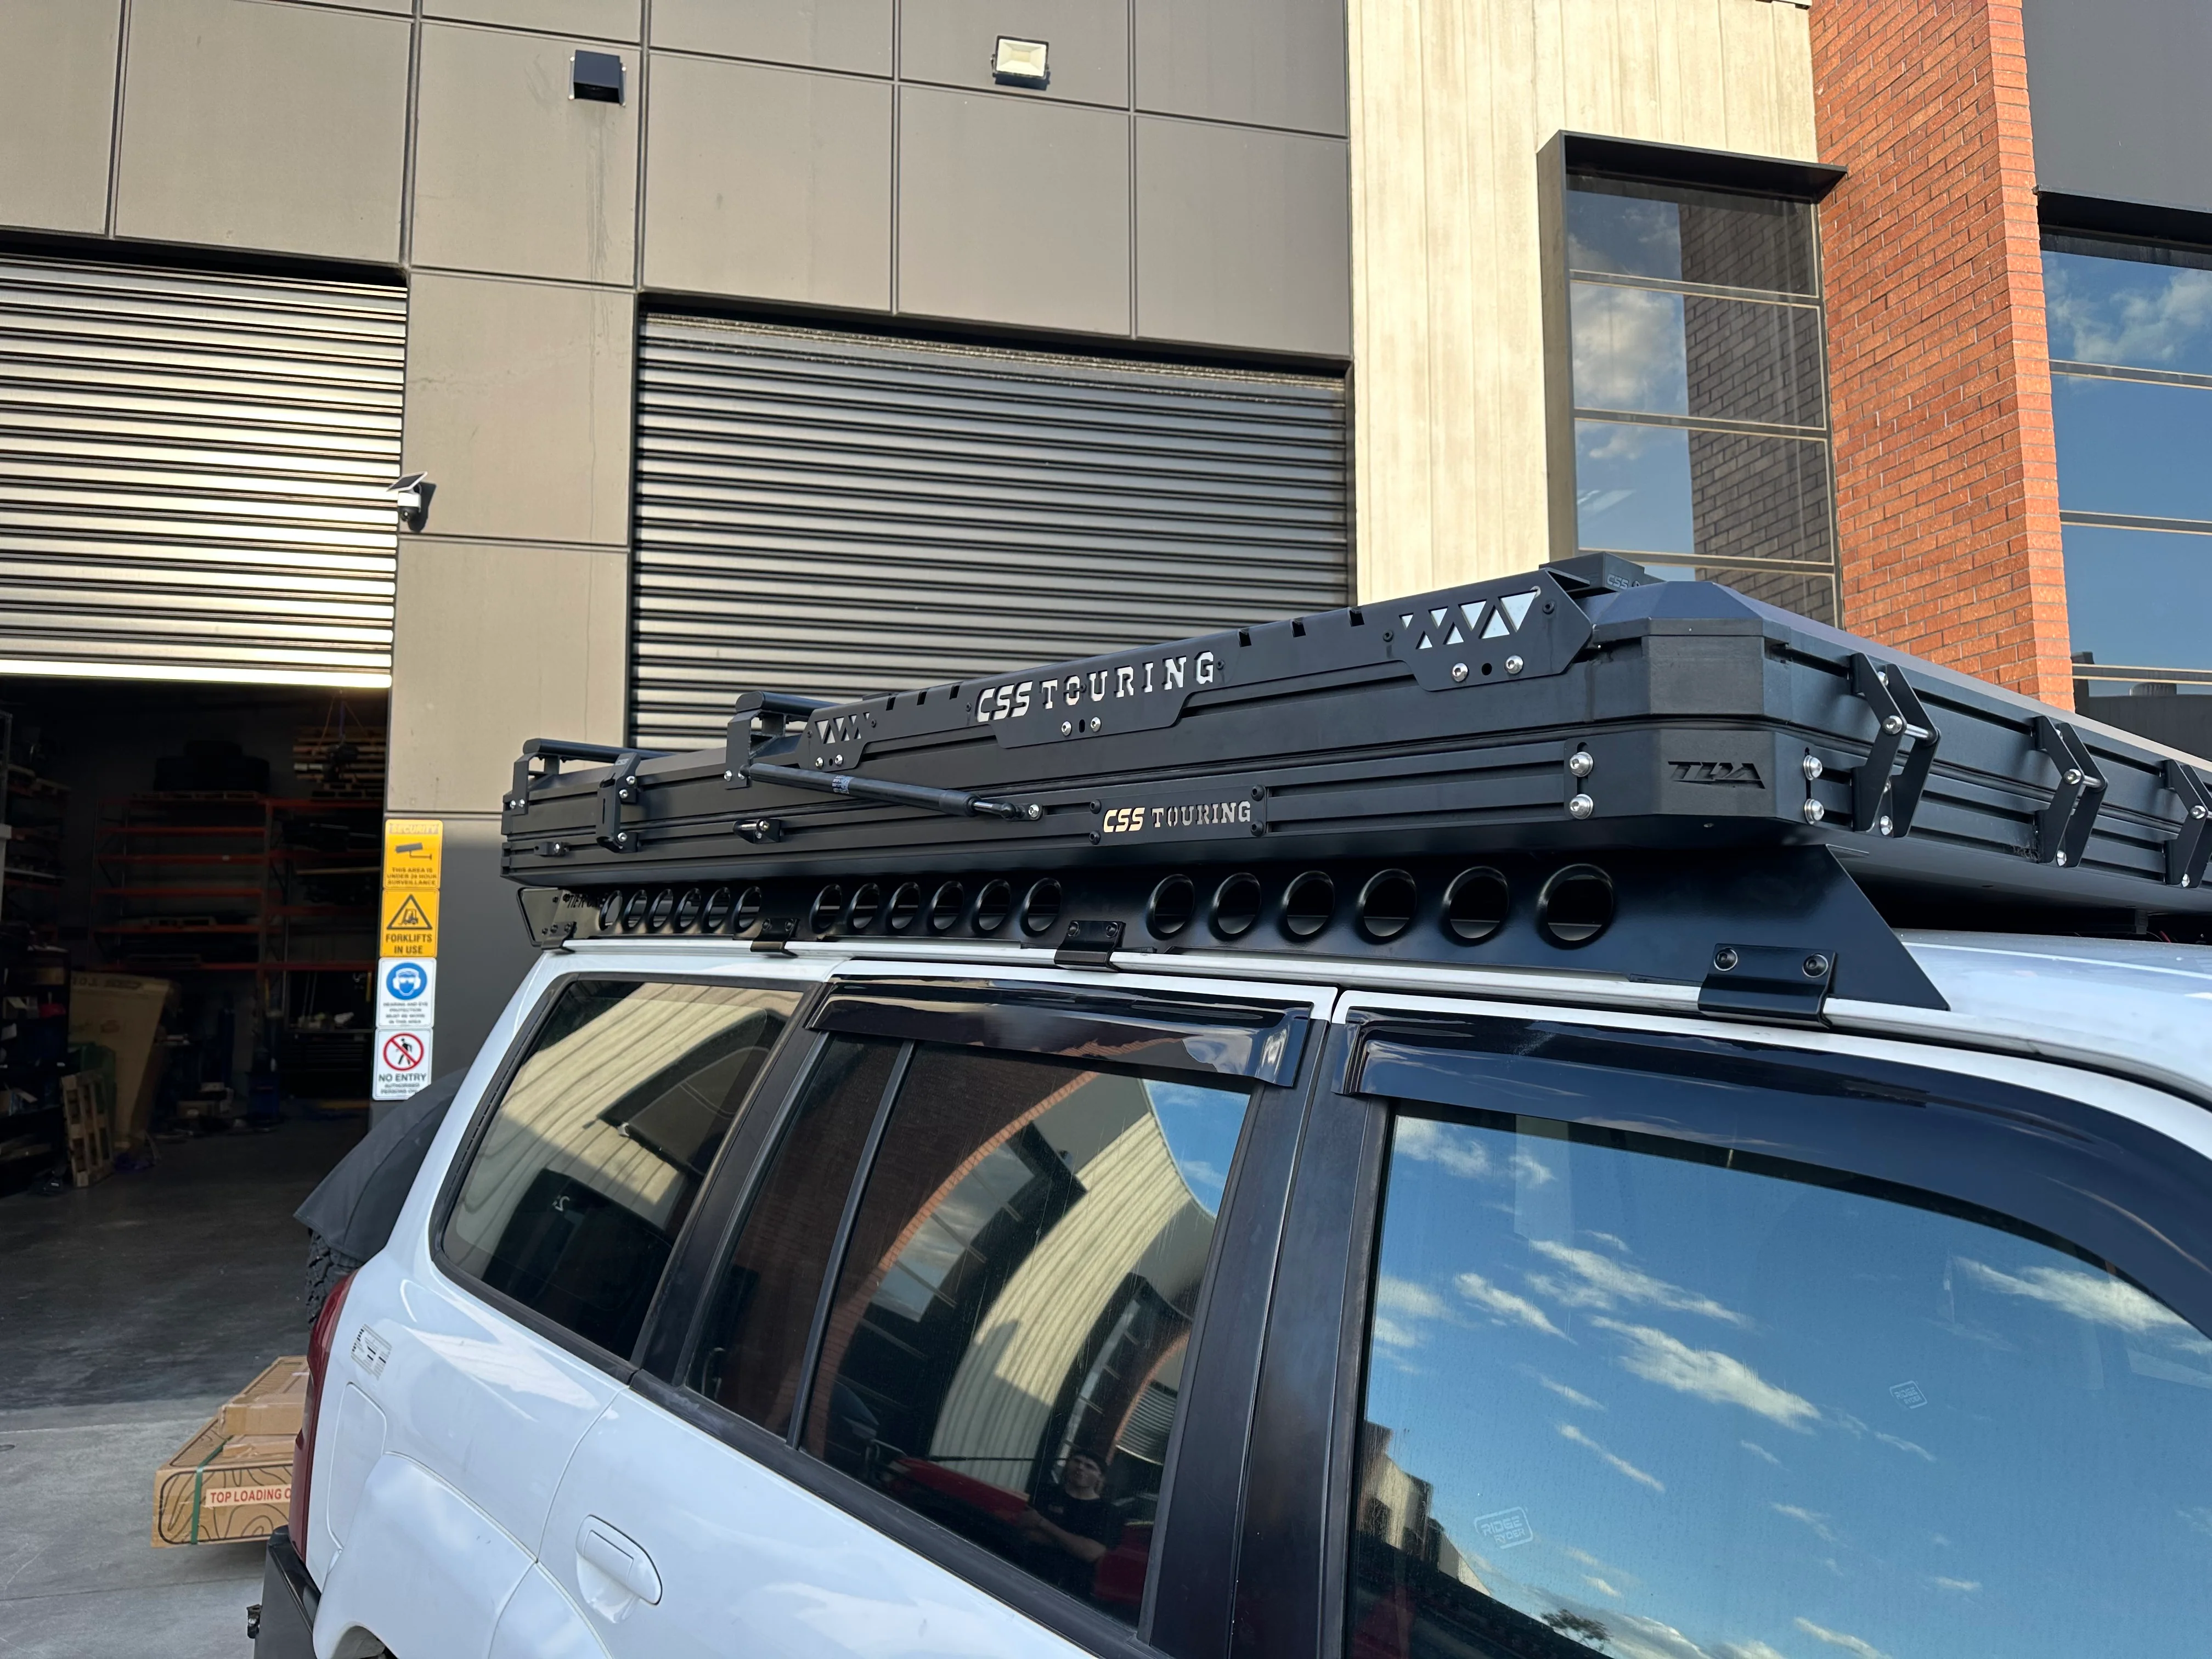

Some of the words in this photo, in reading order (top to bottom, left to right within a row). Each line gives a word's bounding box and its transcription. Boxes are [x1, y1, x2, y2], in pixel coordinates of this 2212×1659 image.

[1607, 573, 1628, 590] CSS
[977, 681, 1033, 723] CSS
[1040, 651, 1214, 710] TOURING
[1103, 807, 1146, 833] CSS
[1151, 801, 1251, 828] TOURING
[391, 823, 438, 833] SECURITY
[385, 934, 432, 943] FORKLIFTS
[394, 945, 403, 953] IN
[406, 945, 423, 954] USE
[379, 1073, 393, 1082] NO
[396, 1073, 426, 1082] ENTRY
[211, 1492, 231, 1503] TOP
[234, 1488, 282, 1502] LOADING
[1481, 1515, 1523, 1537] RIDGE
[1493, 1528, 1526, 1544] RYDER
